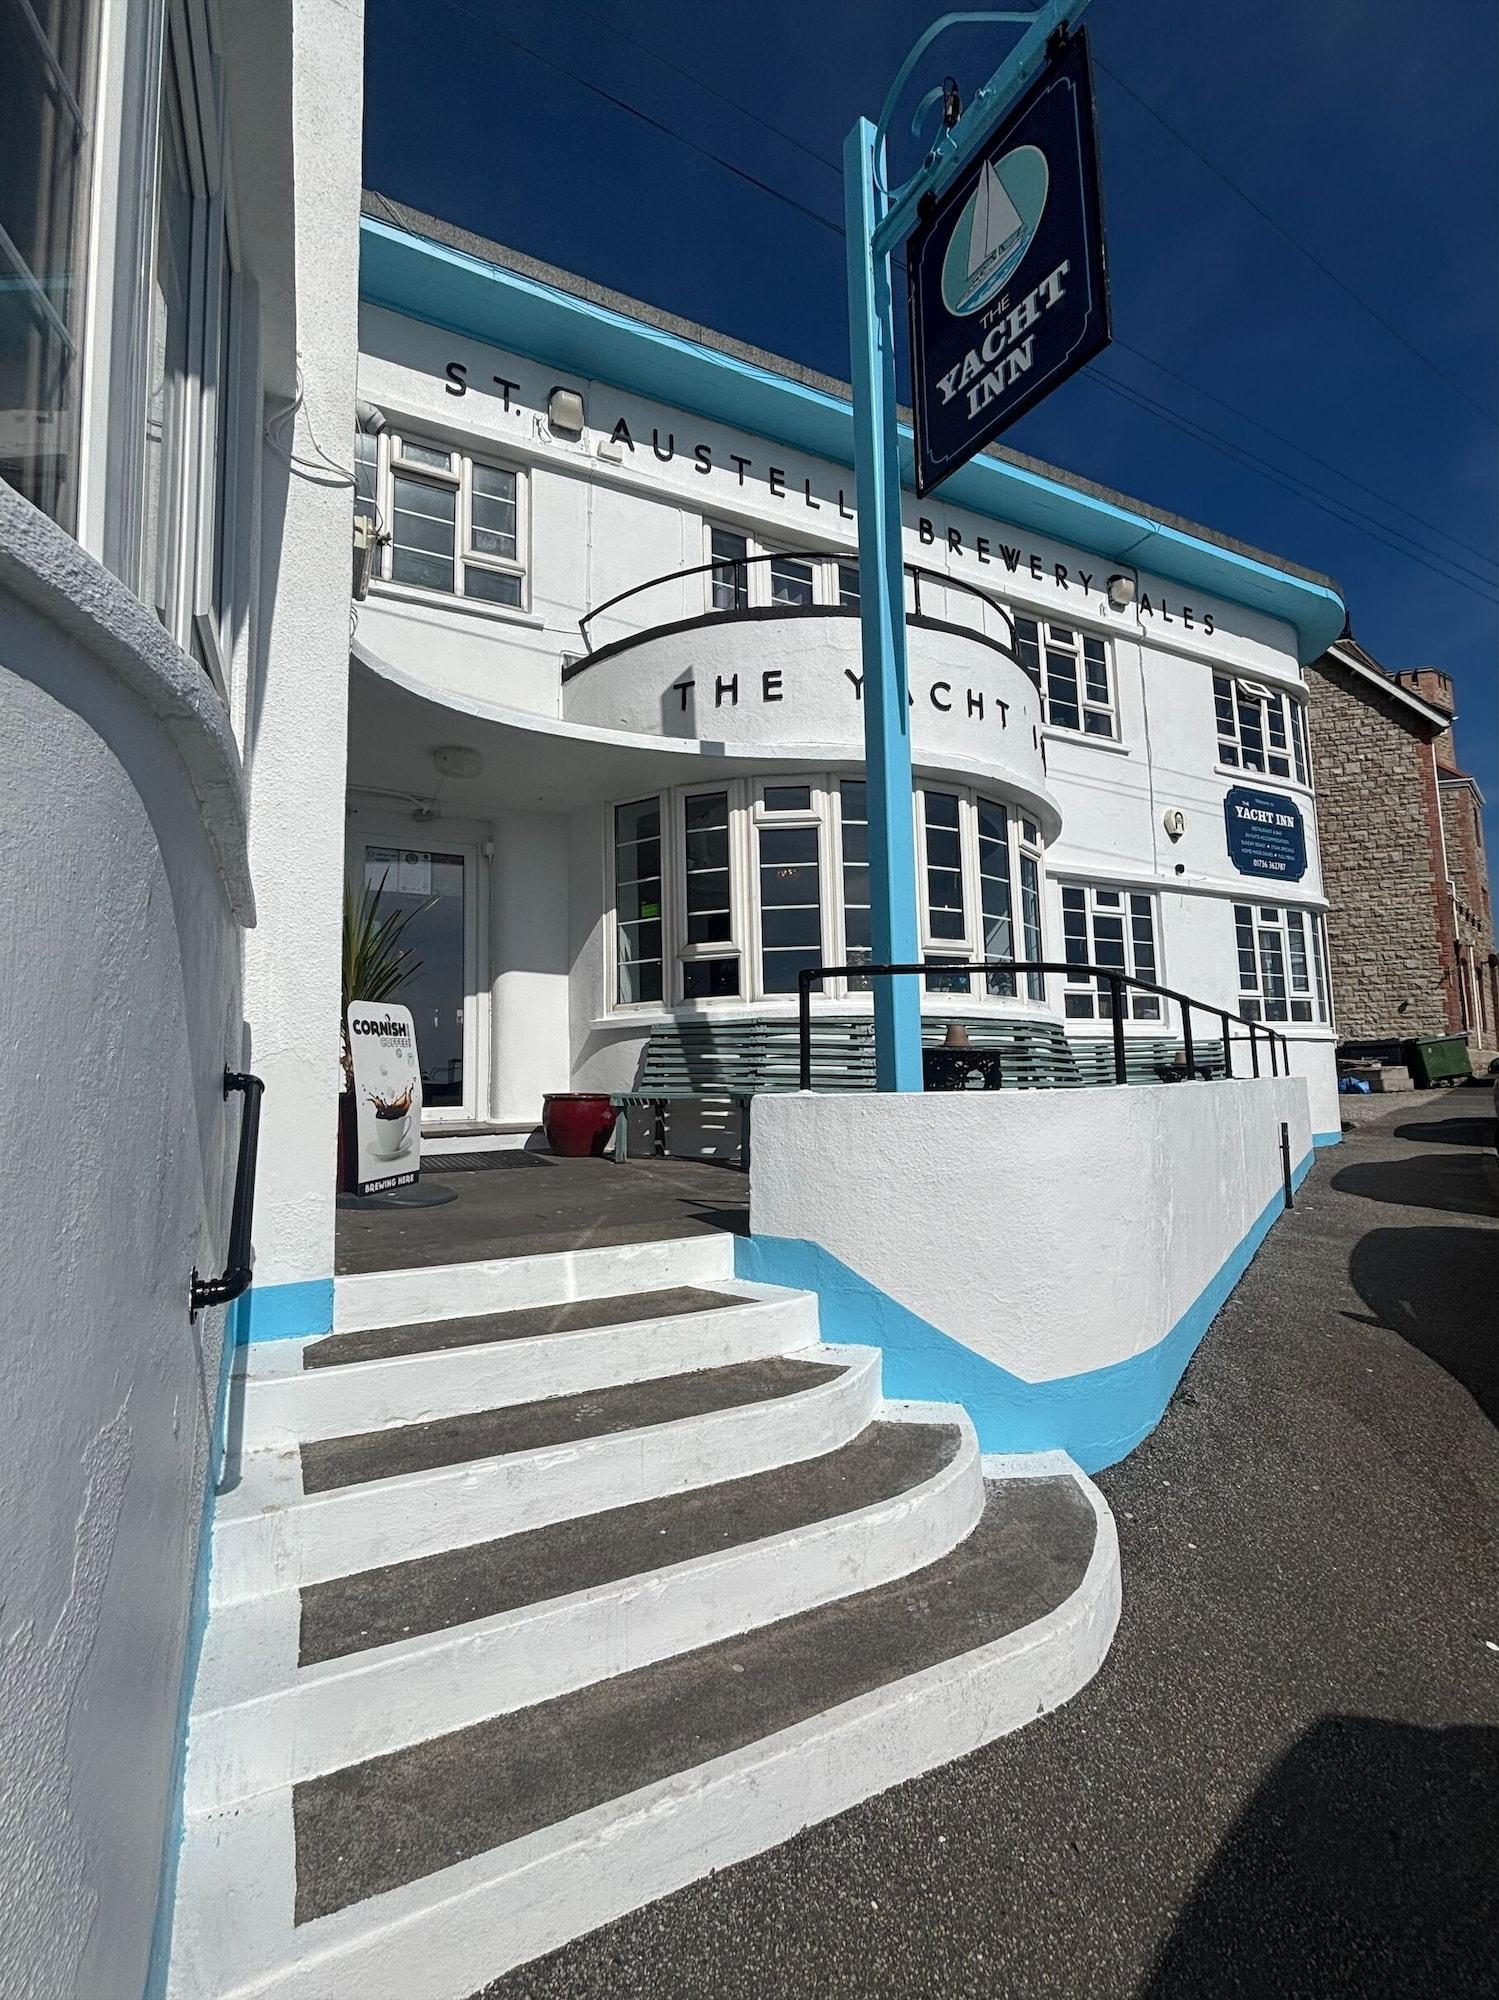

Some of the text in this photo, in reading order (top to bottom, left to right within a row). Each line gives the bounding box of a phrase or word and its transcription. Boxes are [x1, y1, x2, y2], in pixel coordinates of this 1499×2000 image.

[936, 259, 1070, 405] YACHT
[979, 293, 1010, 329] THE
[966, 334, 1035, 420] INN
[445, 362, 1214, 636] ST. AUSTELL BREWERY ALES
[673, 669, 1010, 730] THE YCHT
[1235, 805, 1294, 828] YACHT INN
[352, 1014, 407, 1038] CORNISH
[364, 1174, 414, 1193] BREWING HERE
